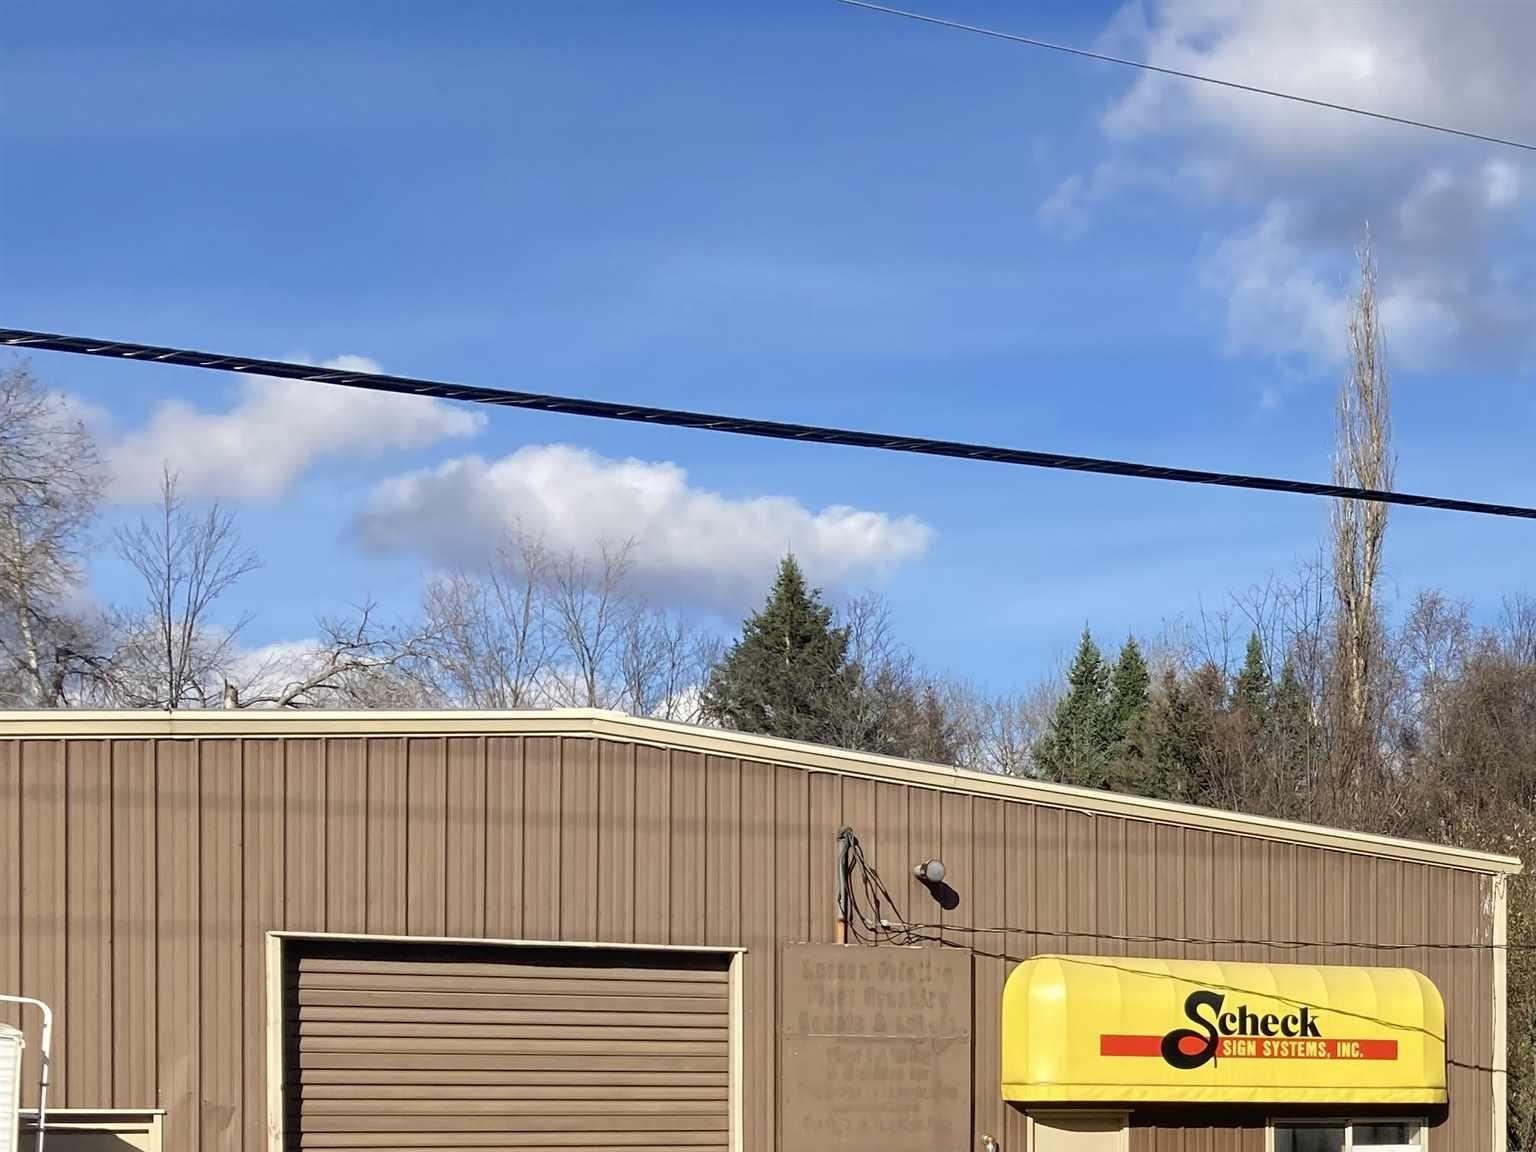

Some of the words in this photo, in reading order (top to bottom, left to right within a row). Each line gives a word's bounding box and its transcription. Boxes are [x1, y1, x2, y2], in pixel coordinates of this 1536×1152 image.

[1161, 990, 1322, 1069] Scheck
[1223, 1039, 1258, 1056] SIGN
[1262, 1041, 1331, 1058] SYSTEMS,
[1337, 1042, 1364, 1058] INC.
